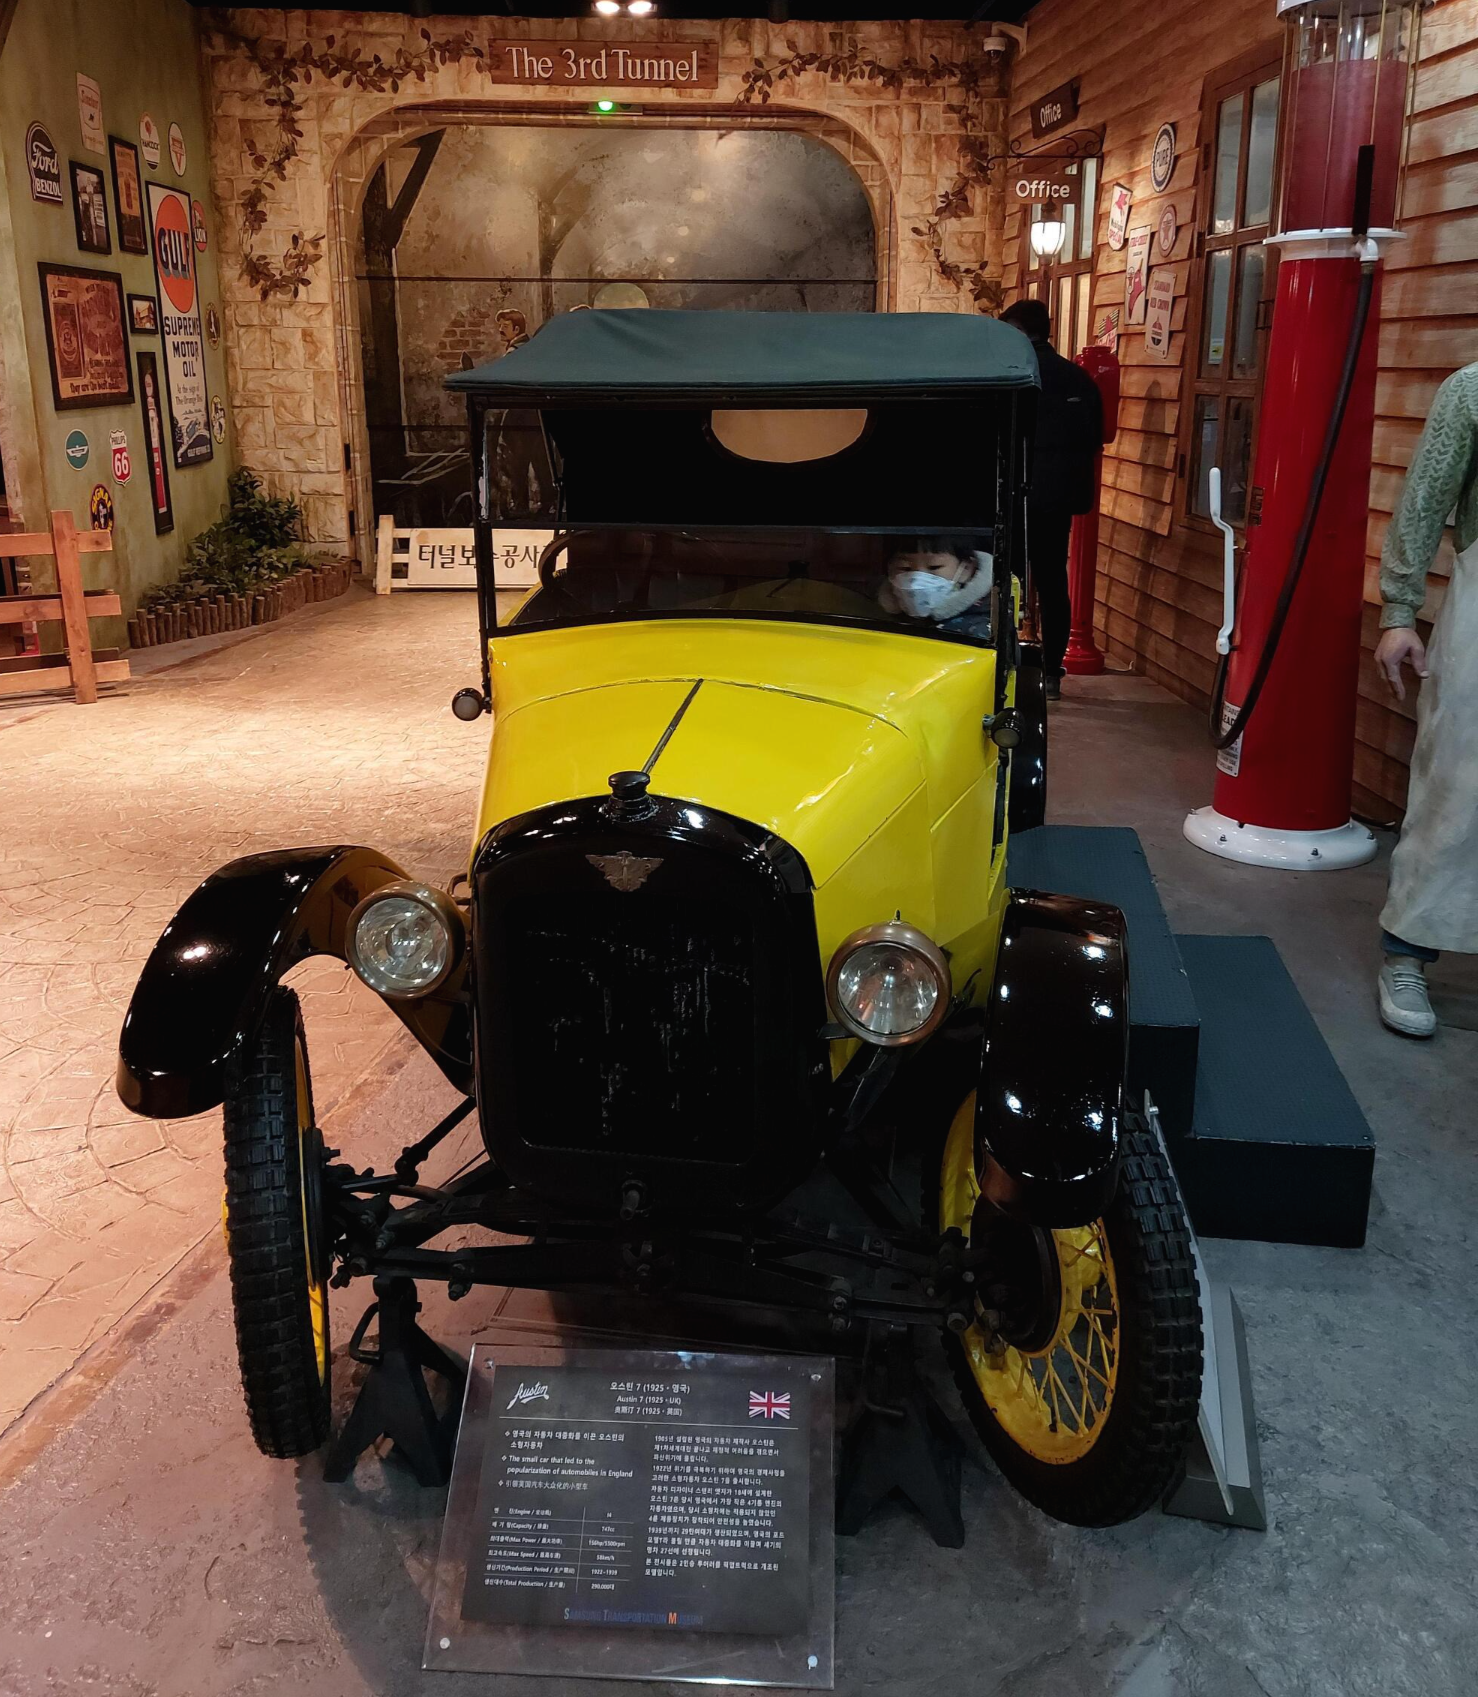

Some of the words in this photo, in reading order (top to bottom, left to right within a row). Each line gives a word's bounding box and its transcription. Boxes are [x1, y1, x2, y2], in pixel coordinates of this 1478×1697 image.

[506, 47, 553, 79] The
[562, 49, 607, 79] 3rd
[611, 50, 699, 81] Tunnel
[1040, 103, 1061, 128] Office
[32, 142, 58, 174] Ford
[36, 178, 61, 196] BENZOL
[1016, 180, 1070, 197] Office
[164, 316, 200, 336] SUPREME
[172, 341, 199, 358] MOTOR
[183, 361, 196, 377] OIL
[115, 452, 128, 476] 66
[507, 1381, 549, 1409] Austin
[610, 1382, 633, 1391] 오스틴
[643, 1384, 664, 1393] (1925
[672, 1384, 690, 1394] 영국)
[556, 1431, 580, 1440] 대중화를
[511, 1441, 543, 1449] 소형자동차
[507, 1466, 550, 1474] popularization
[561, 1468, 598, 1476] automobiles
[608, 1470, 633, 1478] England
